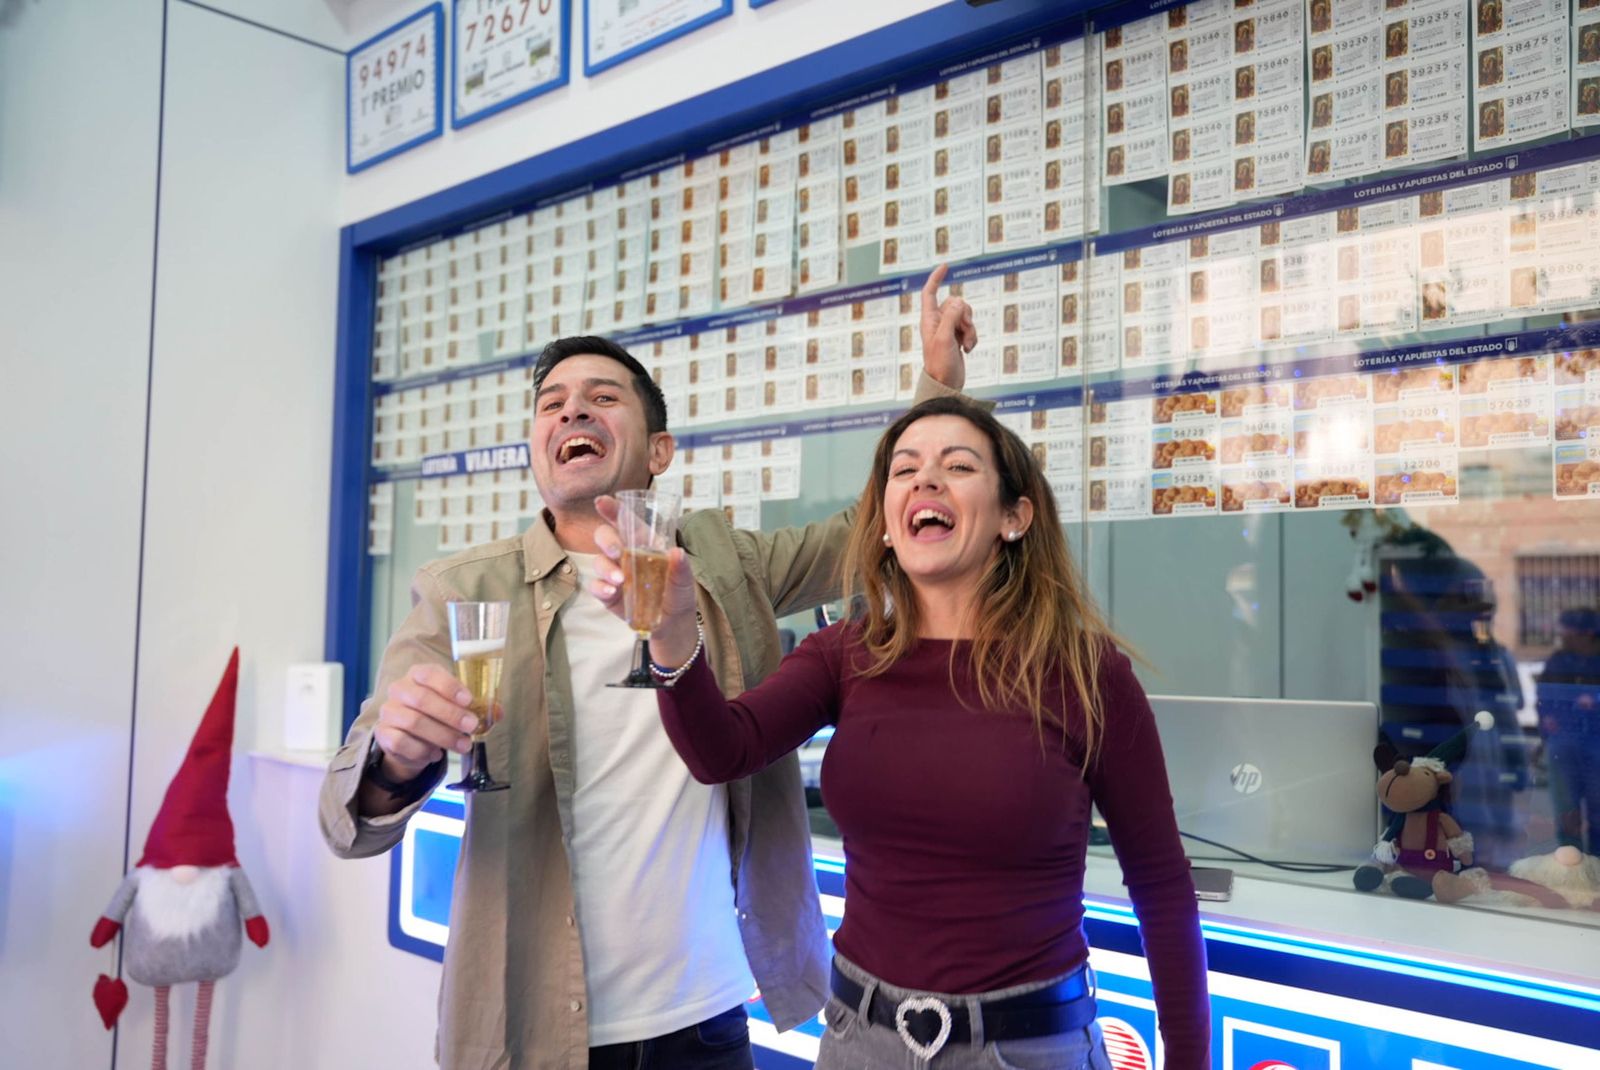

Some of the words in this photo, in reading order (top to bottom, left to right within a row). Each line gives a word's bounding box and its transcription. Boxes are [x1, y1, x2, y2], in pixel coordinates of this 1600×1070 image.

[1411, 11, 1449, 29] 39235
[1335, 35, 1368, 52] 19230
[1506, 36, 1549, 55] 38475
[360, 33, 426, 88] 94974
[1411, 62, 1449, 78] 39235
[372, 68, 425, 111] PREMIO
[1335, 84, 1368, 101] 19230
[1507, 89, 1550, 107] 38475
[1411, 112, 1449, 129] 39235
[1354, 183, 1397, 198] LOTERÍAS
[1402, 173, 1448, 189] APUESTAS
[1449, 171, 1466, 179] DEL
[1467, 162, 1503, 175] ESTADO
[1153, 227, 1187, 239] LOTERÍAS
[1229, 215, 1243, 223] DEL
[1243, 209, 1272, 220] ESTADO
[1353, 355, 1397, 367] LOTERÍAS
[1402, 349, 1448, 361] APUESTAS
[1449, 348, 1466, 356] DEL
[1467, 343, 1503, 354] ESTADO
[1228, 373, 1242, 381] DEL
[1243, 370, 1271, 380] ESTADO
[466, 445, 529, 473] VIAJERA
[1231, 763, 1261, 793] hp
